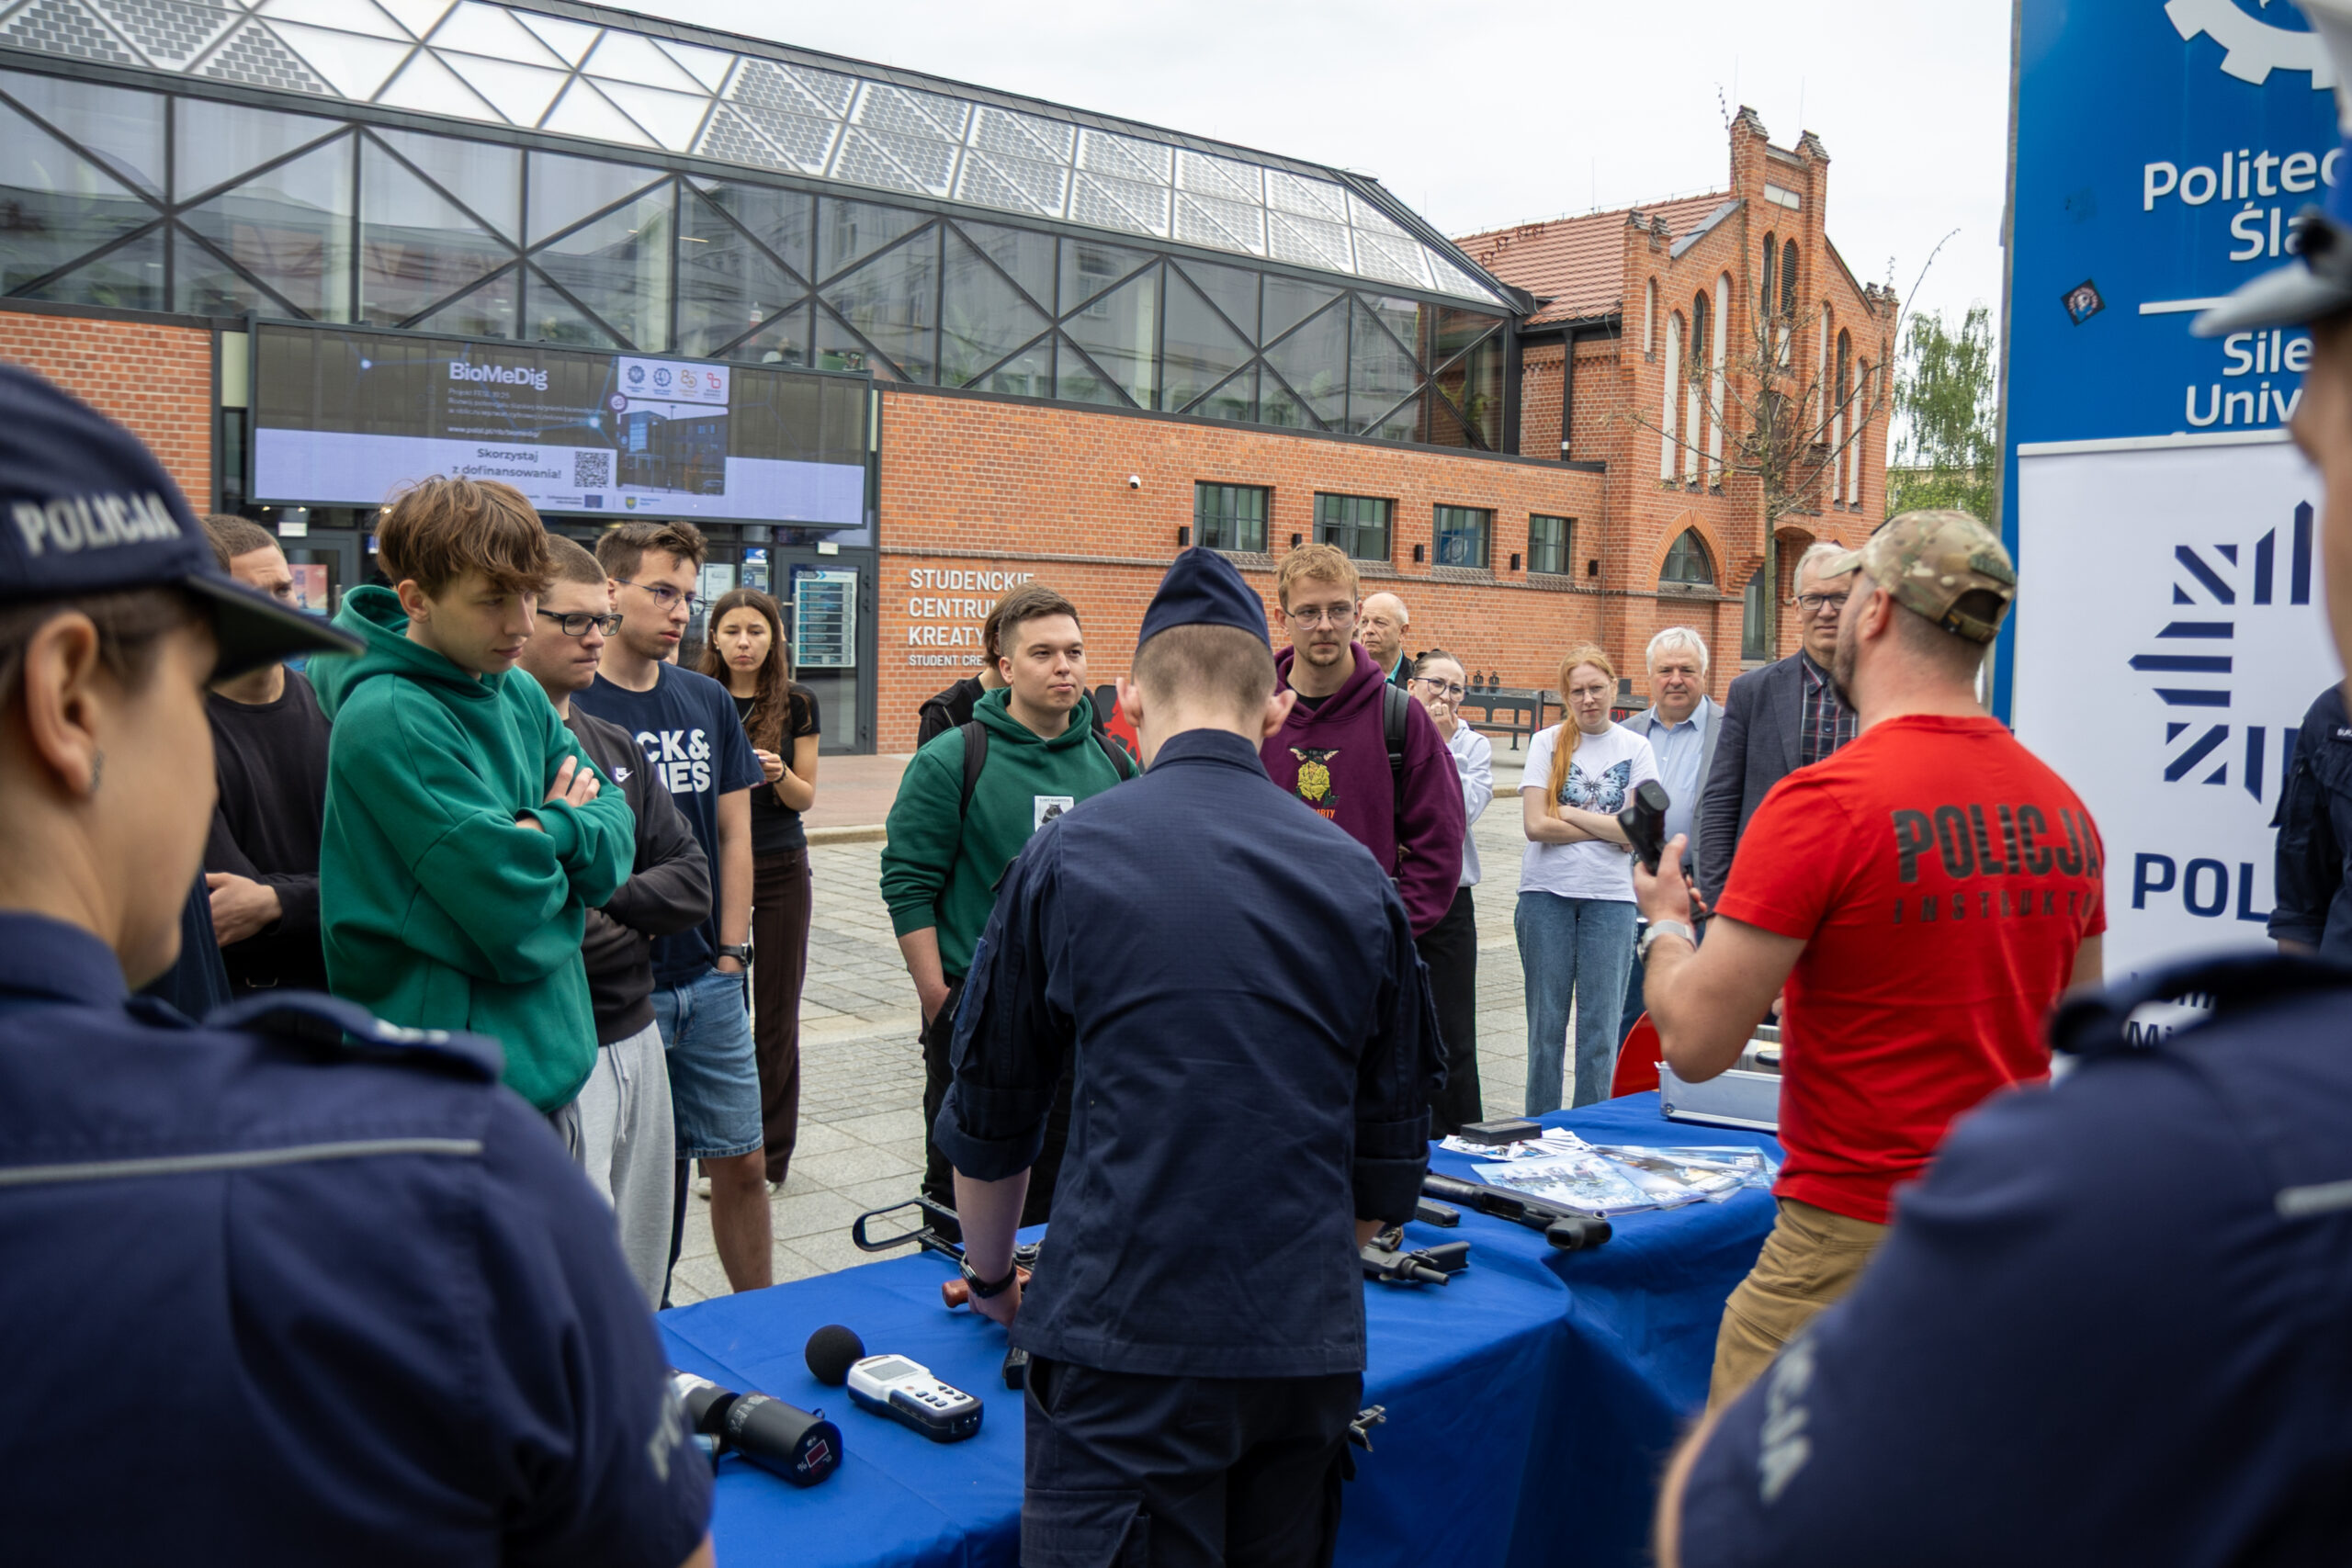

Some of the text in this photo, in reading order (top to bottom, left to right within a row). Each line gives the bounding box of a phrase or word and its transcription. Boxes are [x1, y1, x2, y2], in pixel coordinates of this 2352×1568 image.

[2222, 330, 2314, 376] Sile
[449, 361, 548, 391] BioMeDig
[2186, 381, 2303, 427] Univ
[452, 465, 561, 479] z dofinansowania!
[477, 447, 539, 463] Skorzystaj
[12, 492, 182, 557] POLICJA
[909, 597, 997, 618] CENTRU
[909, 655, 986, 666] STUDENT CRE
[1891, 804, 2100, 883] POLICJA
[2132, 852, 2271, 923] POL
